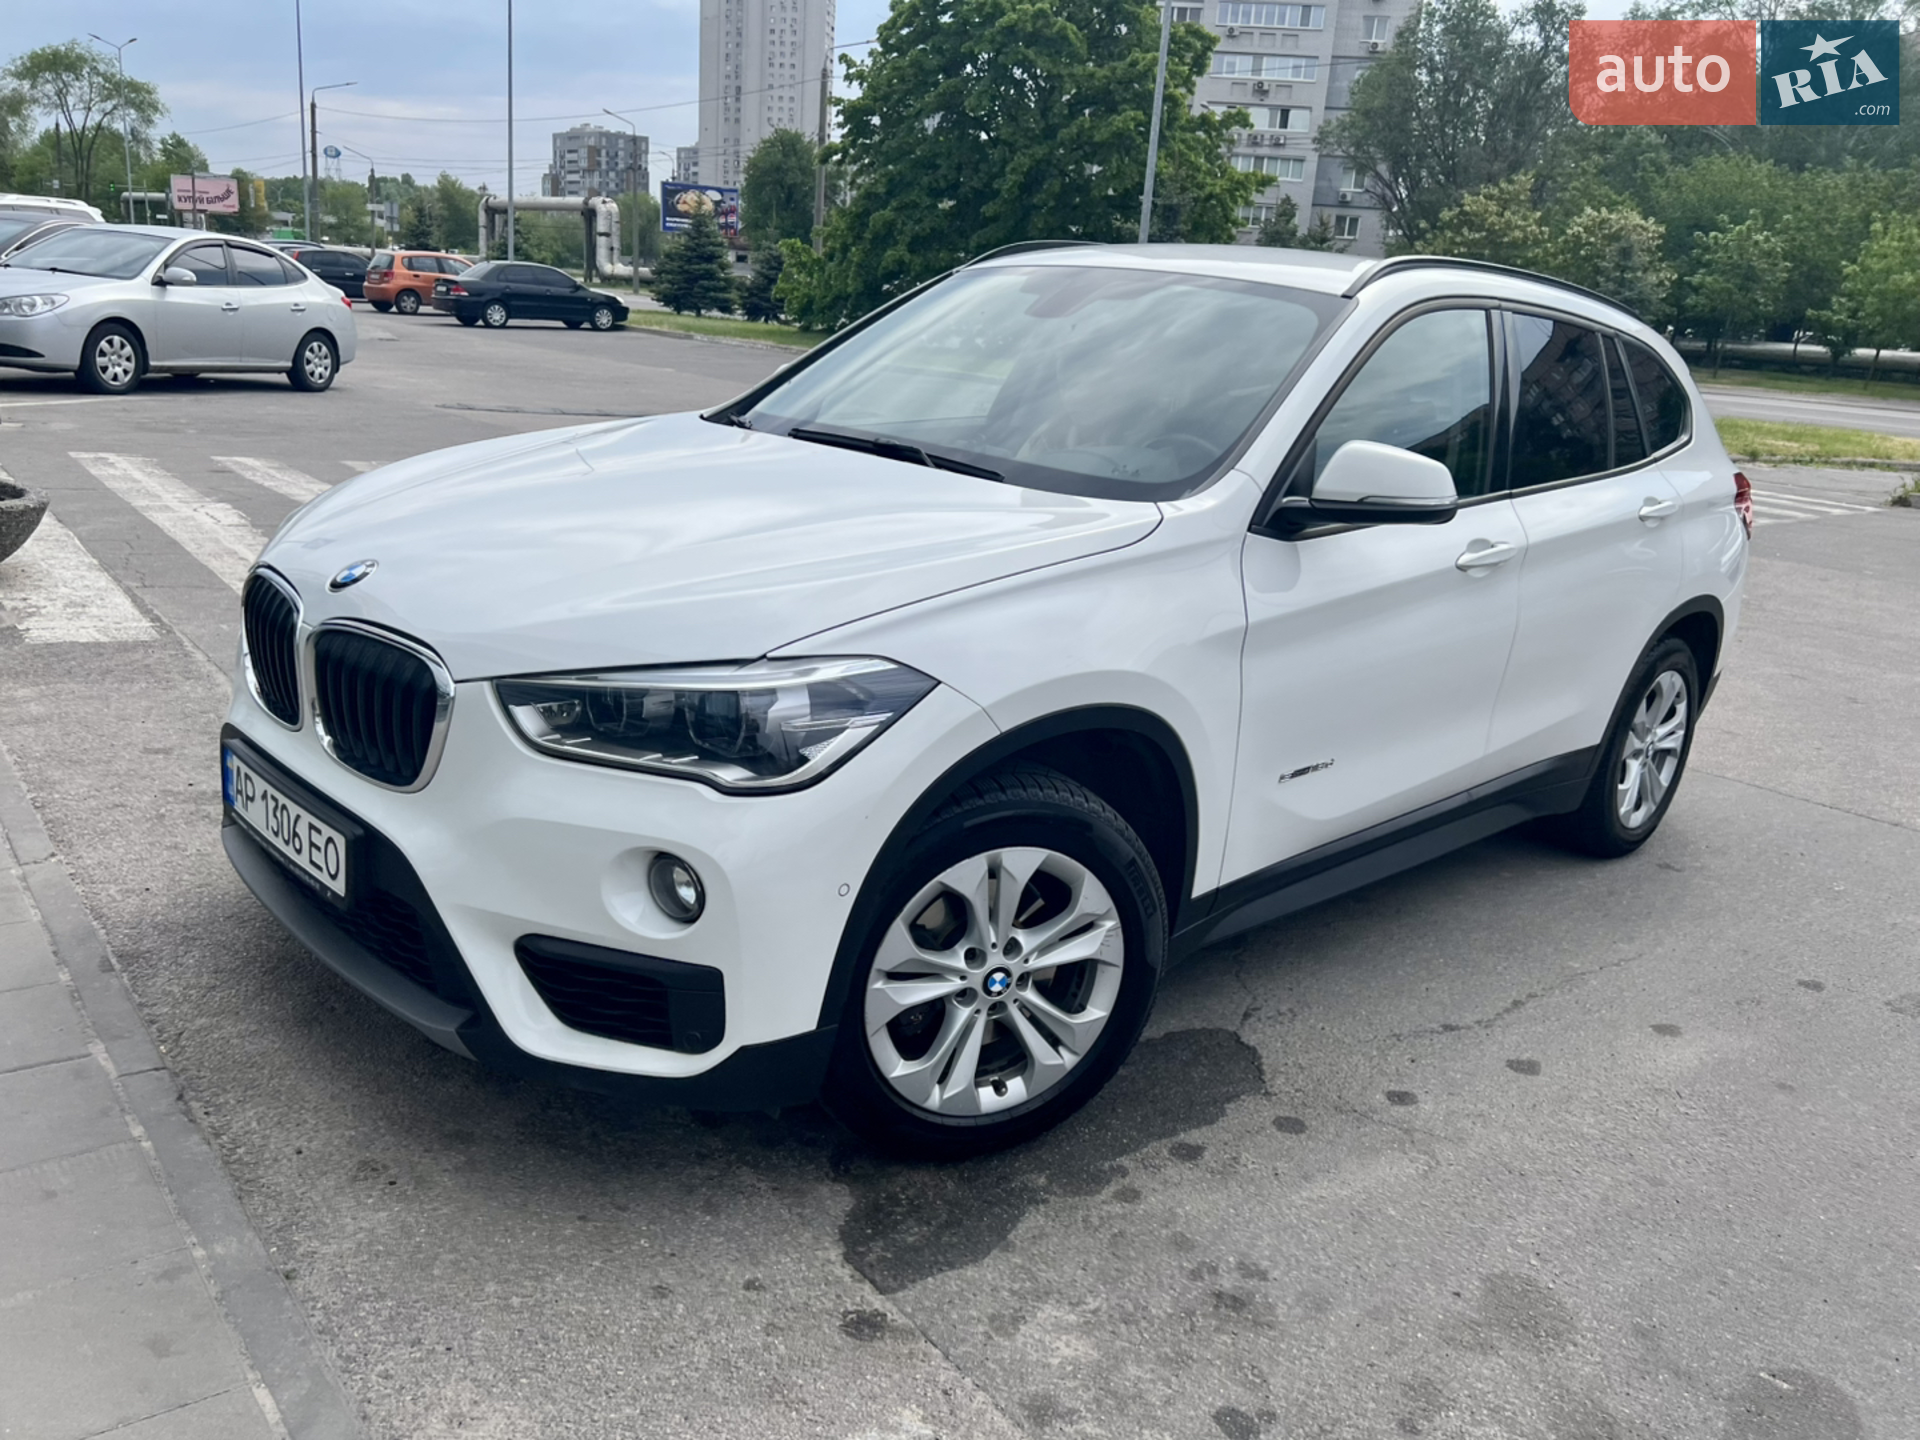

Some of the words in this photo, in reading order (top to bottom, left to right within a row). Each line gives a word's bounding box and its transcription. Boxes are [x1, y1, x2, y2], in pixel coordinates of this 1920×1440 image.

[235, 765, 256, 812] AP
[261, 789, 303, 855] 1306
[308, 821, 340, 881] EO
